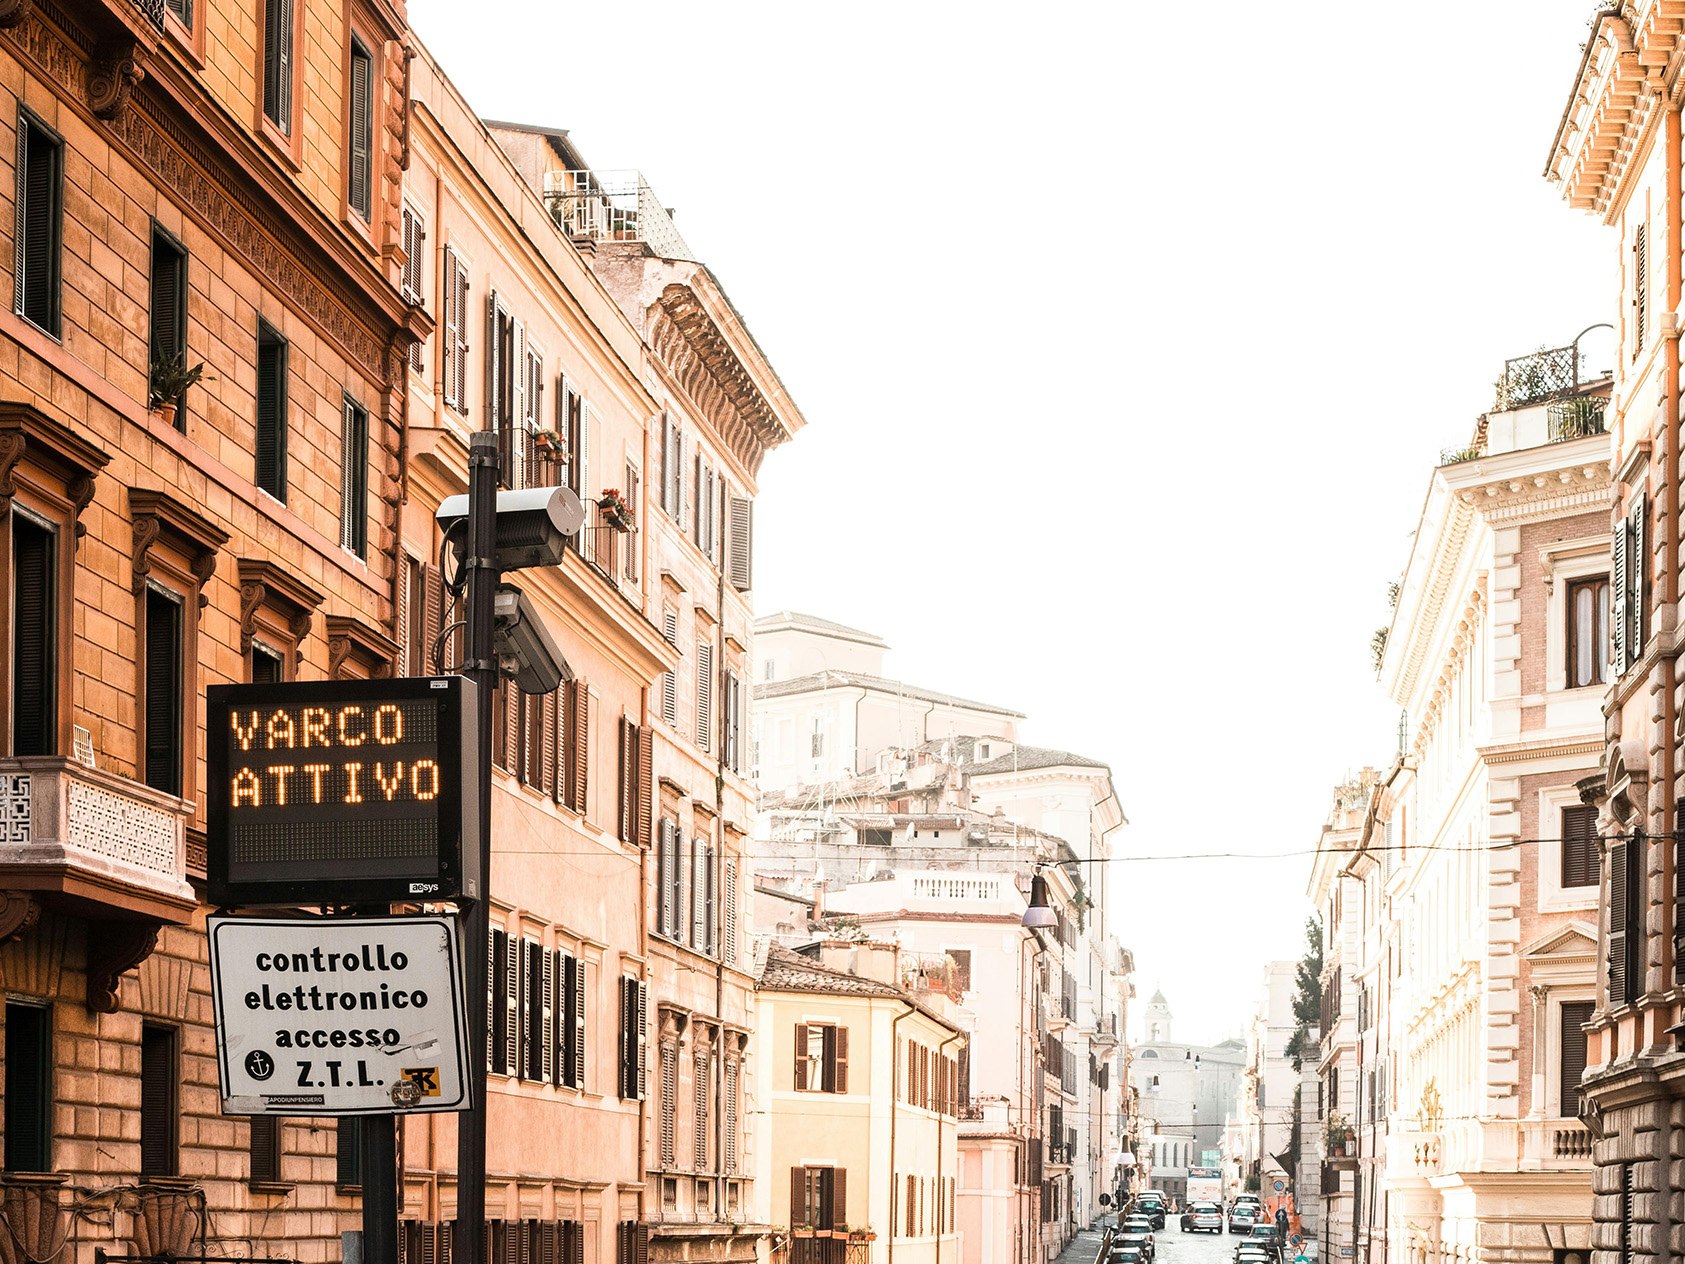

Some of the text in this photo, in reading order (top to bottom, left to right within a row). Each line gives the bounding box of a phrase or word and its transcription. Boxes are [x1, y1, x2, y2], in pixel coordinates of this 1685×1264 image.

[231, 704, 403, 751] VARCO
[231, 759, 440, 807] ATTIVO
[411, 883, 440, 893] aesys
[255, 943, 409, 973] controllo
[244, 982, 429, 1011] elettronico
[274, 1027, 401, 1049] accesso
[295, 1060, 385, 1088] Z.T.L.
